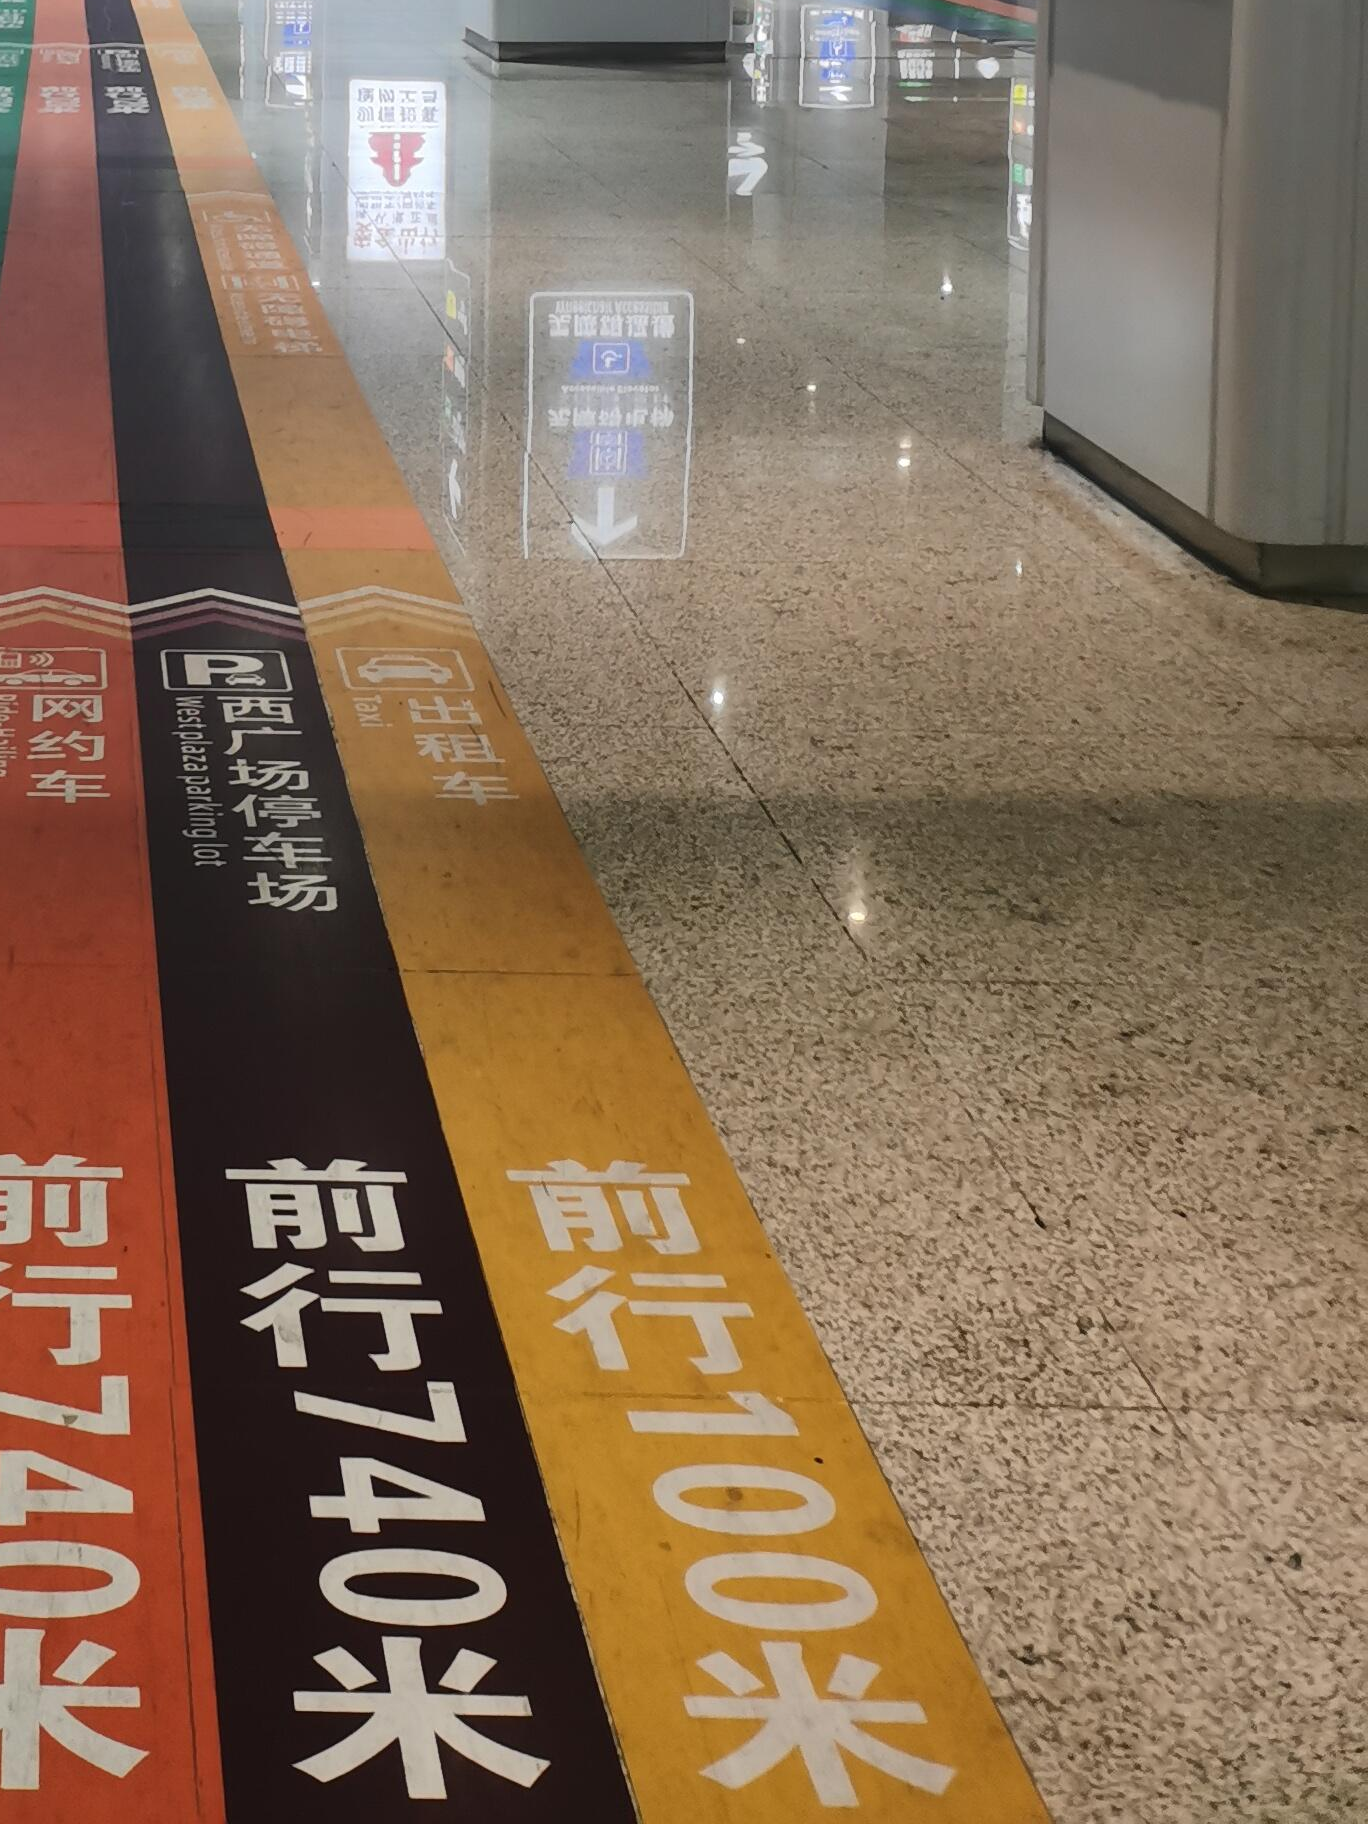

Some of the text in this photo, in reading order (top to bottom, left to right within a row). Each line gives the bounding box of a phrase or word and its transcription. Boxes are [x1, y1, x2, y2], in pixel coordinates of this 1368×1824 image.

[25, 694, 111, 804] 网约车
[174, 695, 225, 868] West plaza parking lot
[352, 695, 390, 729] Taxi
[407, 696, 520, 805] 出租车
[216, 695, 339, 912] 西广场停车场
[225, 1157, 551, 1800] 前行740米
[506, 1158, 958, 1808] 前行100米
